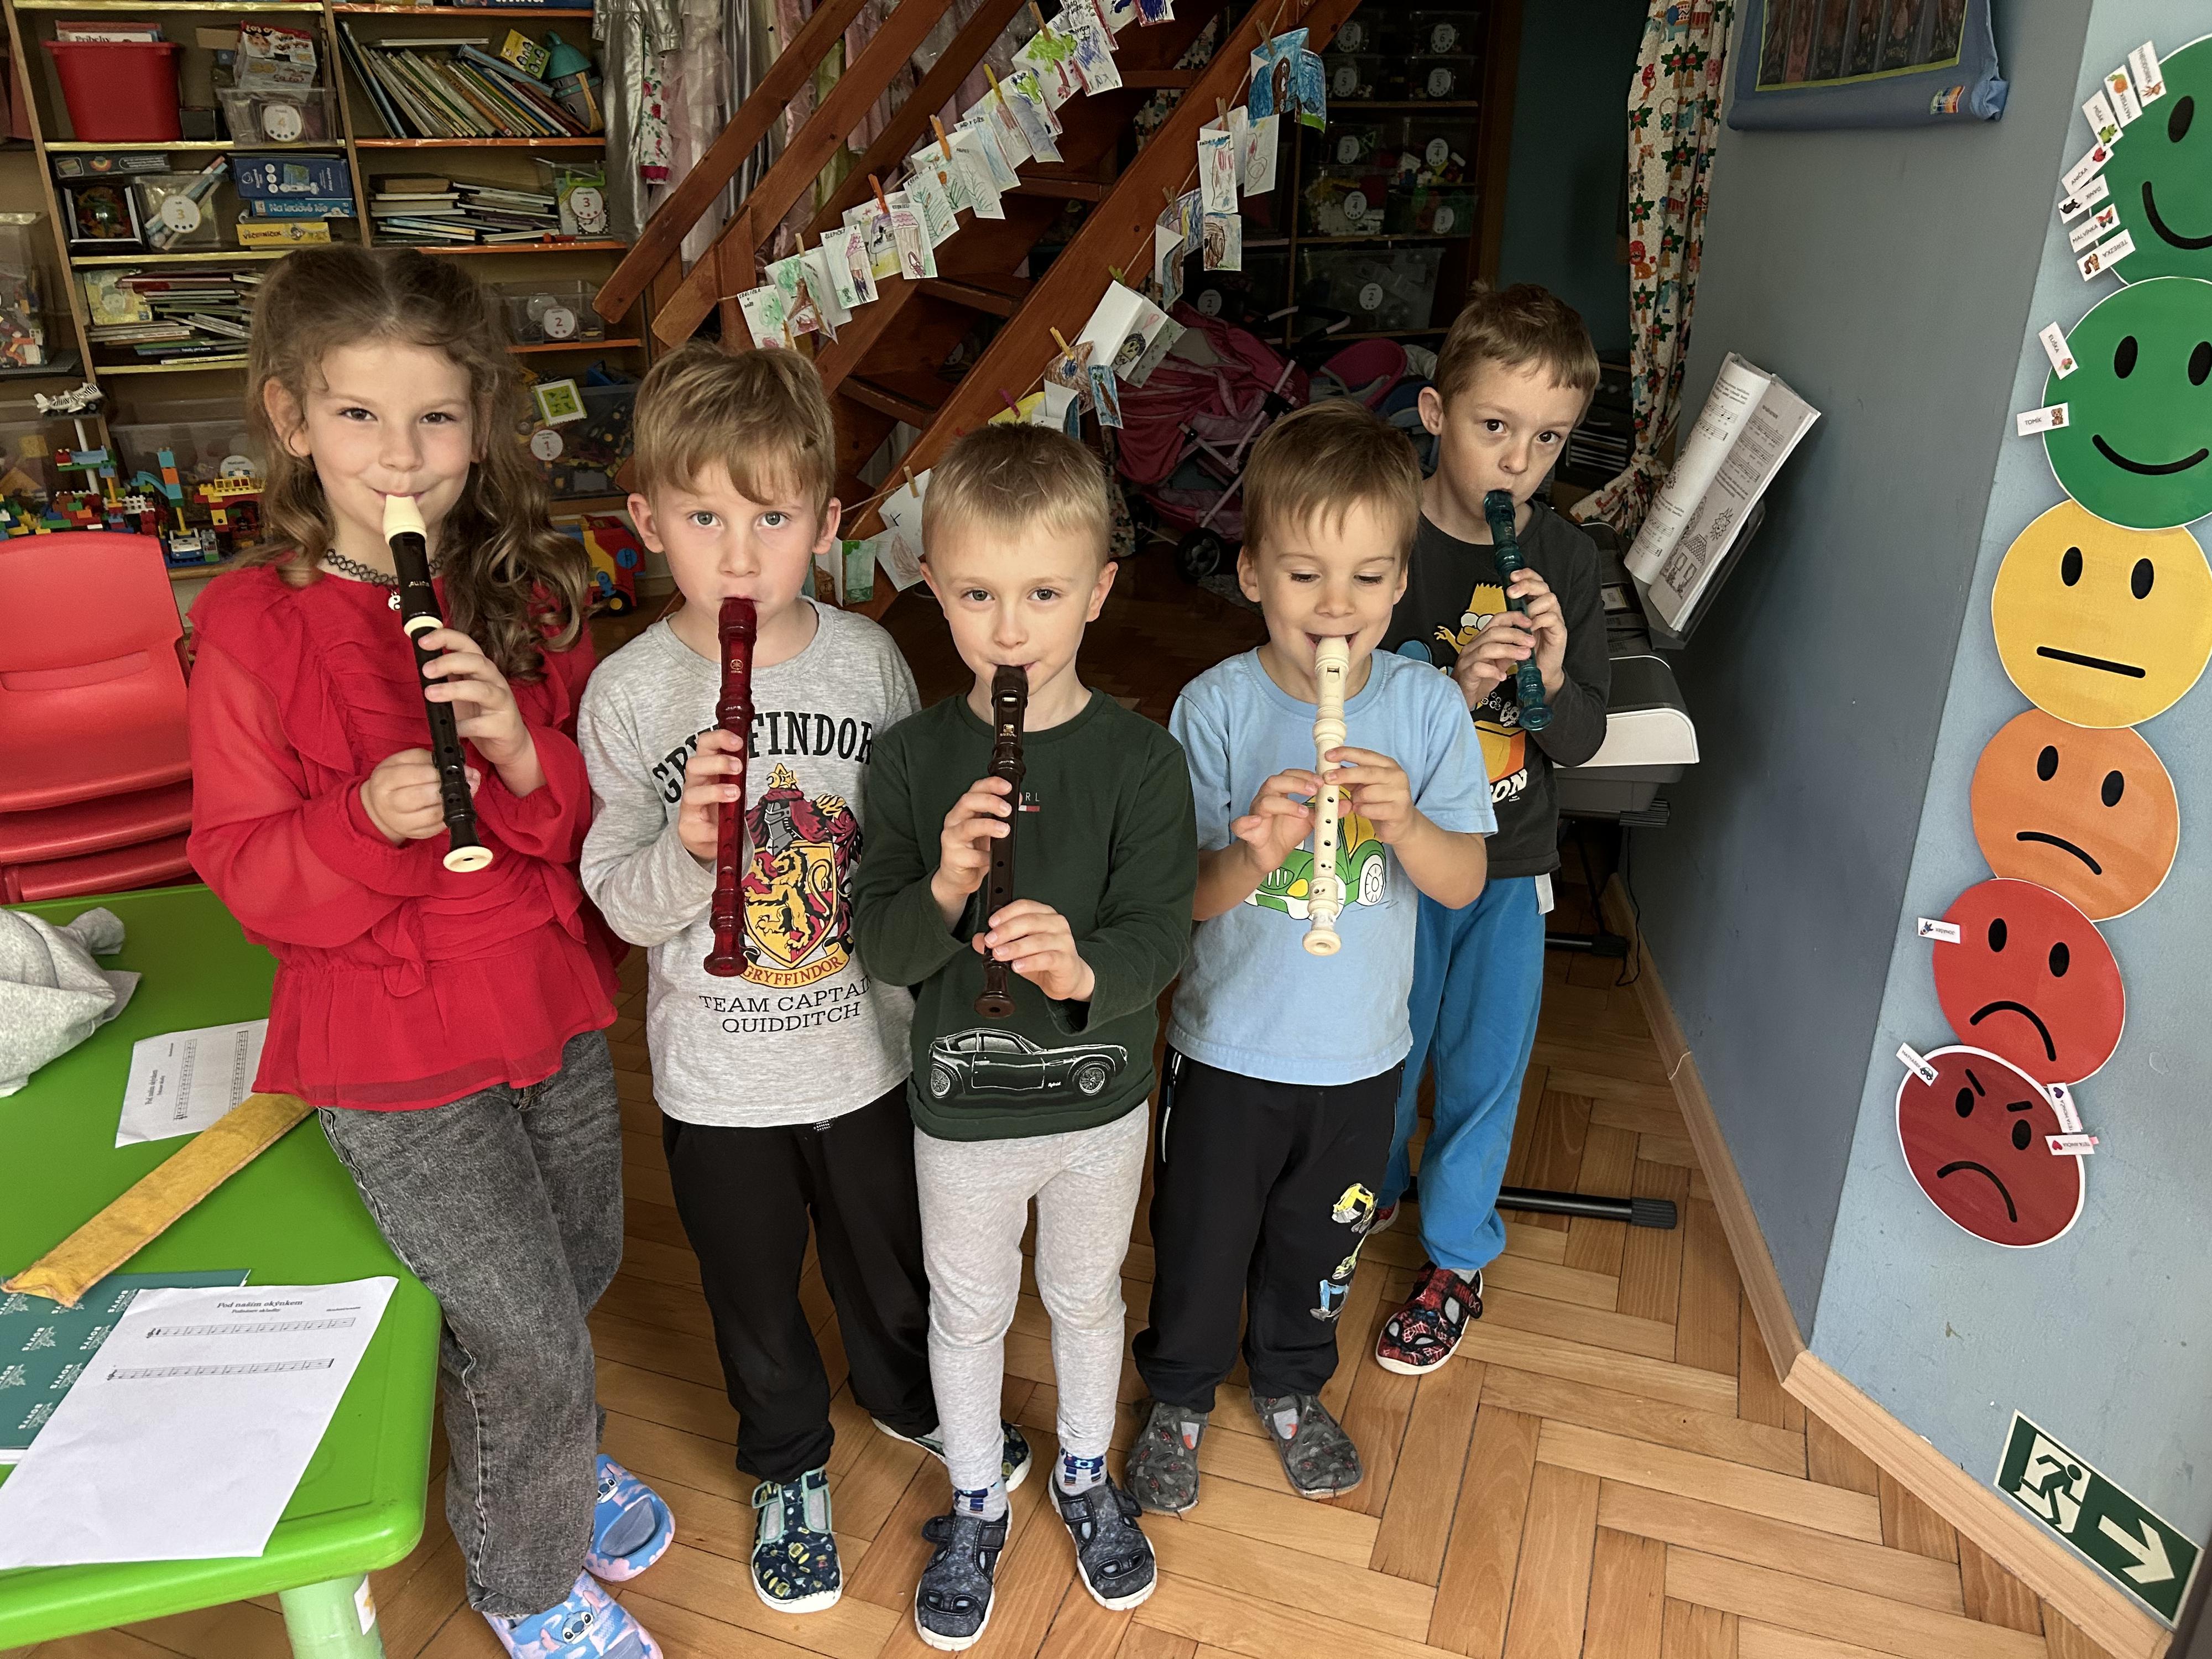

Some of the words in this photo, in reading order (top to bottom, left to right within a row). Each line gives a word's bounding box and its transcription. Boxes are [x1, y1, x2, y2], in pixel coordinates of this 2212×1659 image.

[2071, 168, 2088, 185] ANIČKA
[583, 197, 591, 207] 3
[2072, 224, 2098, 243] MALVÍNKA
[2102, 239, 2128, 258] TEREZKA
[555, 317, 564, 327] 2
[2025, 417, 2042, 426] TOMÍK
[544, 441, 550, 450] 1
[653, 712, 873, 804] GRFINDOR
[1490, 769, 1527, 803] ON
[743, 956, 843, 985] GRYFFINDOR
[699, 995, 770, 1013] TEAM
[722, 1001, 860, 1033] QUIDDITCH
